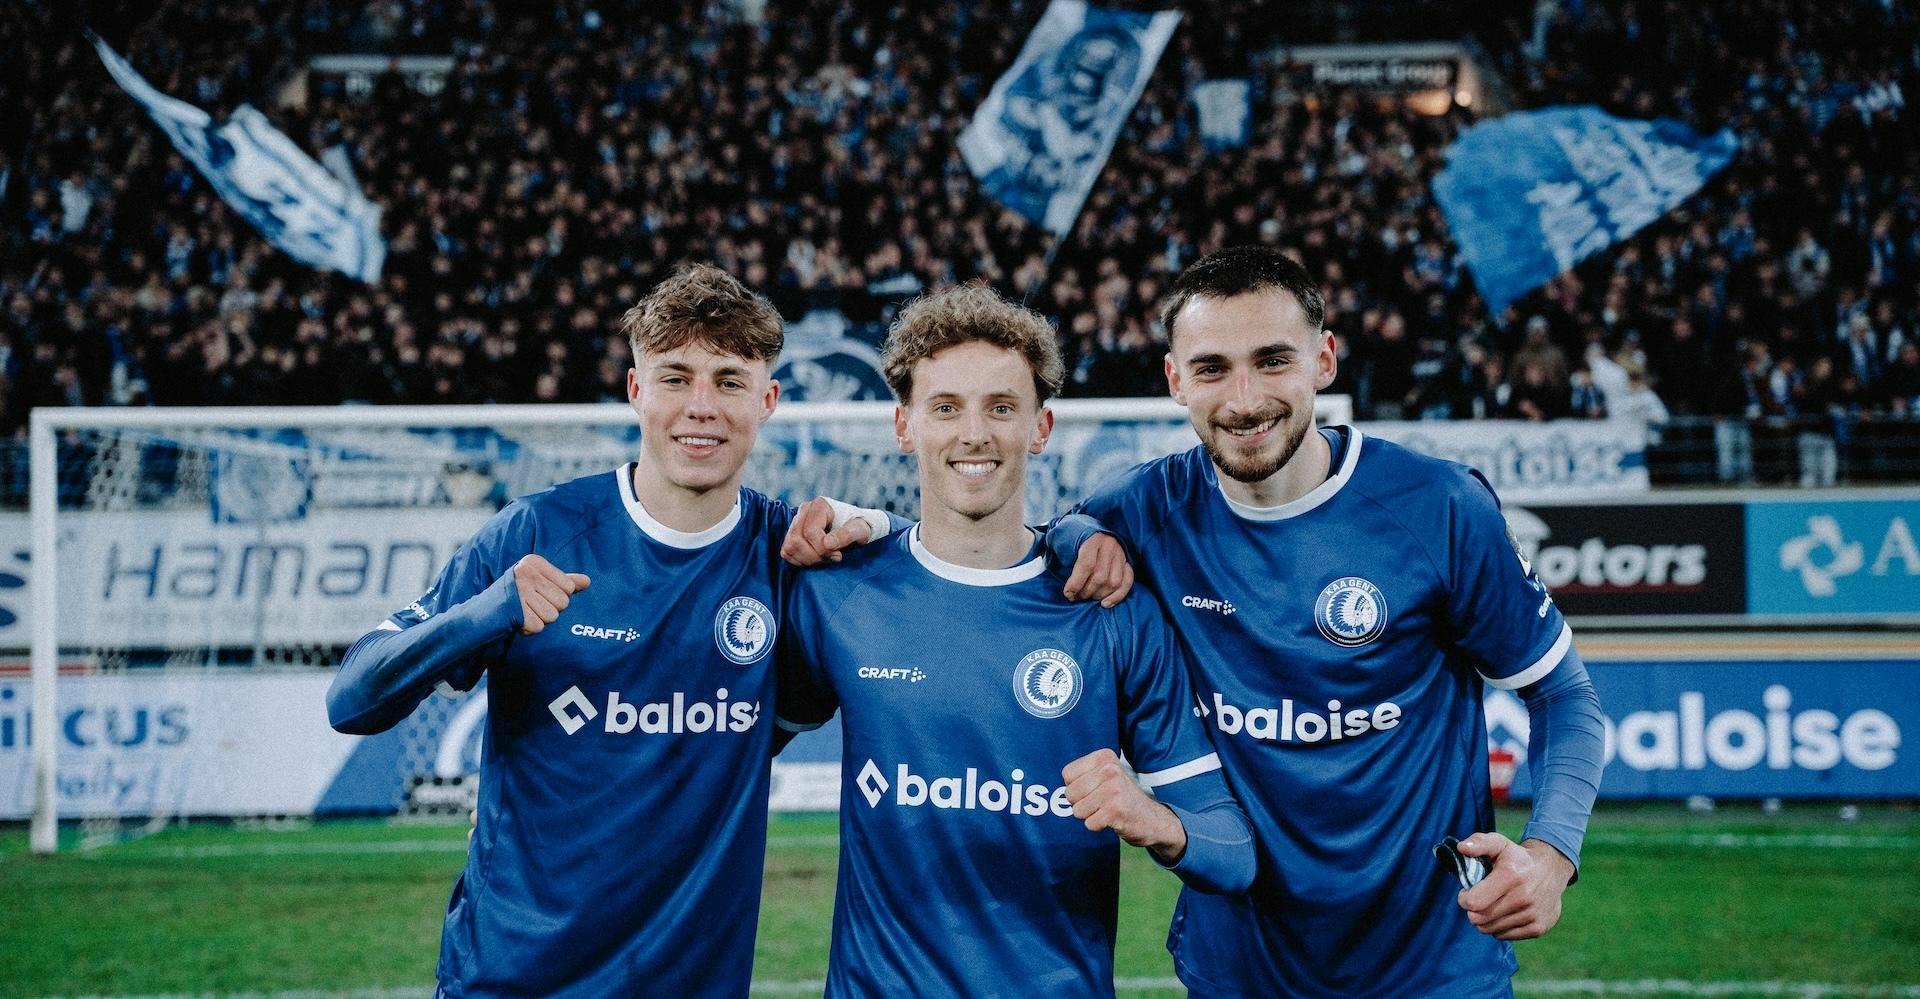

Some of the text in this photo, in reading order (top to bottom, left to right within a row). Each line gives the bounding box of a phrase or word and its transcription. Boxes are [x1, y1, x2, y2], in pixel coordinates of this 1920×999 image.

[105, 541, 465, 598] Haman
[1508, 534, 1707, 588] otors
[1325, 579, 1376, 597] KAA GENT
[723, 599, 766, 614] KAA GENT
[1182, 595, 1223, 613] CRAFT
[571, 624, 625, 641] CRAFT
[1026, 650, 1075, 669] KAA GENT
[858, 666, 911, 680] CRAFT
[1213, 692, 1402, 742] baloise
[1604, 683, 1901, 772] aloise
